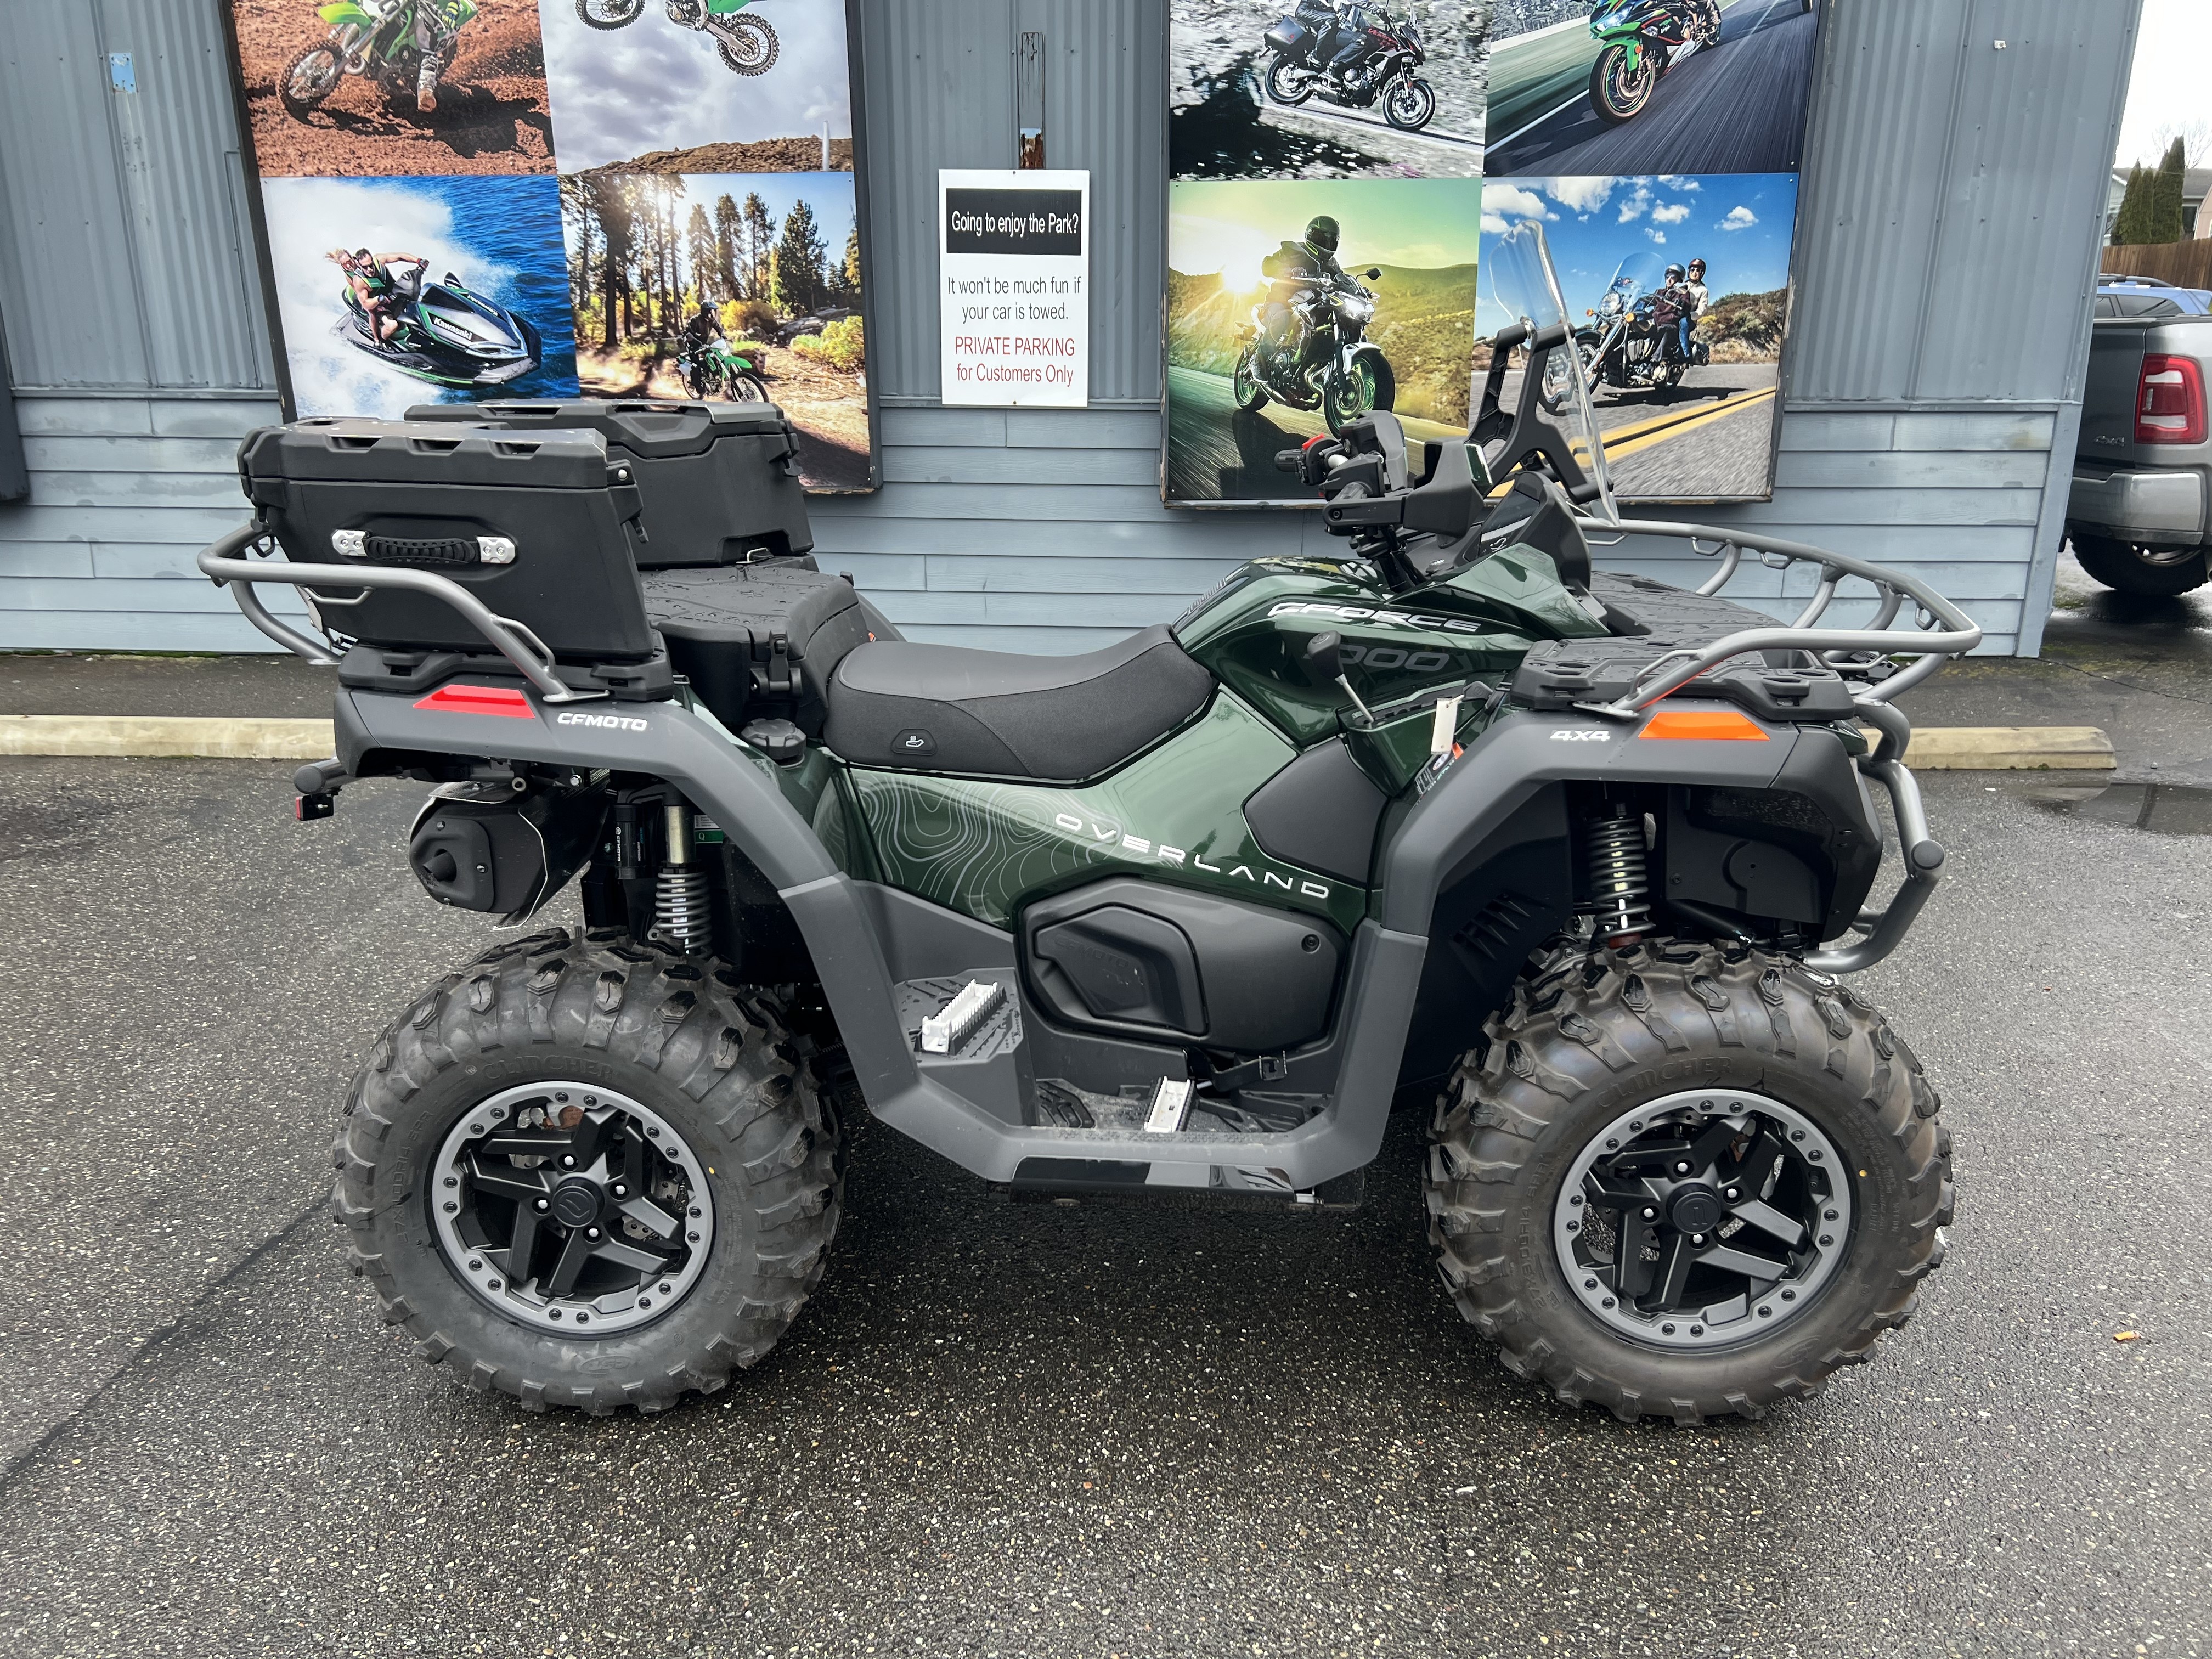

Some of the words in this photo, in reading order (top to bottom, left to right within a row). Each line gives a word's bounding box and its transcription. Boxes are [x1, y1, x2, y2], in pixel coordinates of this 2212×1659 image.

[951, 211, 983, 237] Going
[985, 212, 996, 232] to
[998, 212, 1026, 238] enjoy
[1028, 212, 1046, 233] the
[1048, 213, 1079, 234] Park?
[948, 276, 955, 294] It
[958, 276, 991, 294] won't
[994, 276, 1009, 294] be
[1013, 276, 1047, 294] much
[1050, 275, 1069, 294] fun
[1074, 275, 1081, 294] if
[962, 306, 989, 324] your
[992, 306, 1012, 320] car
[1015, 302, 1025, 320] is
[1029, 302, 1068, 320] towed.
[433, 317, 472, 340] Kawasaki
[955, 336, 1011, 356] PRIVATE
[1015, 337, 1075, 357] PARKING
[957, 363, 973, 381] for
[977, 363, 1042, 382] Customers
[1046, 364, 1074, 387] Only
[1302, 644, 1450, 672] 000
[557, 712, 648, 731] CFMOTO
[1550, 730, 1611, 741] 4X4
[1056, 813, 1329, 899] OVERLAND
